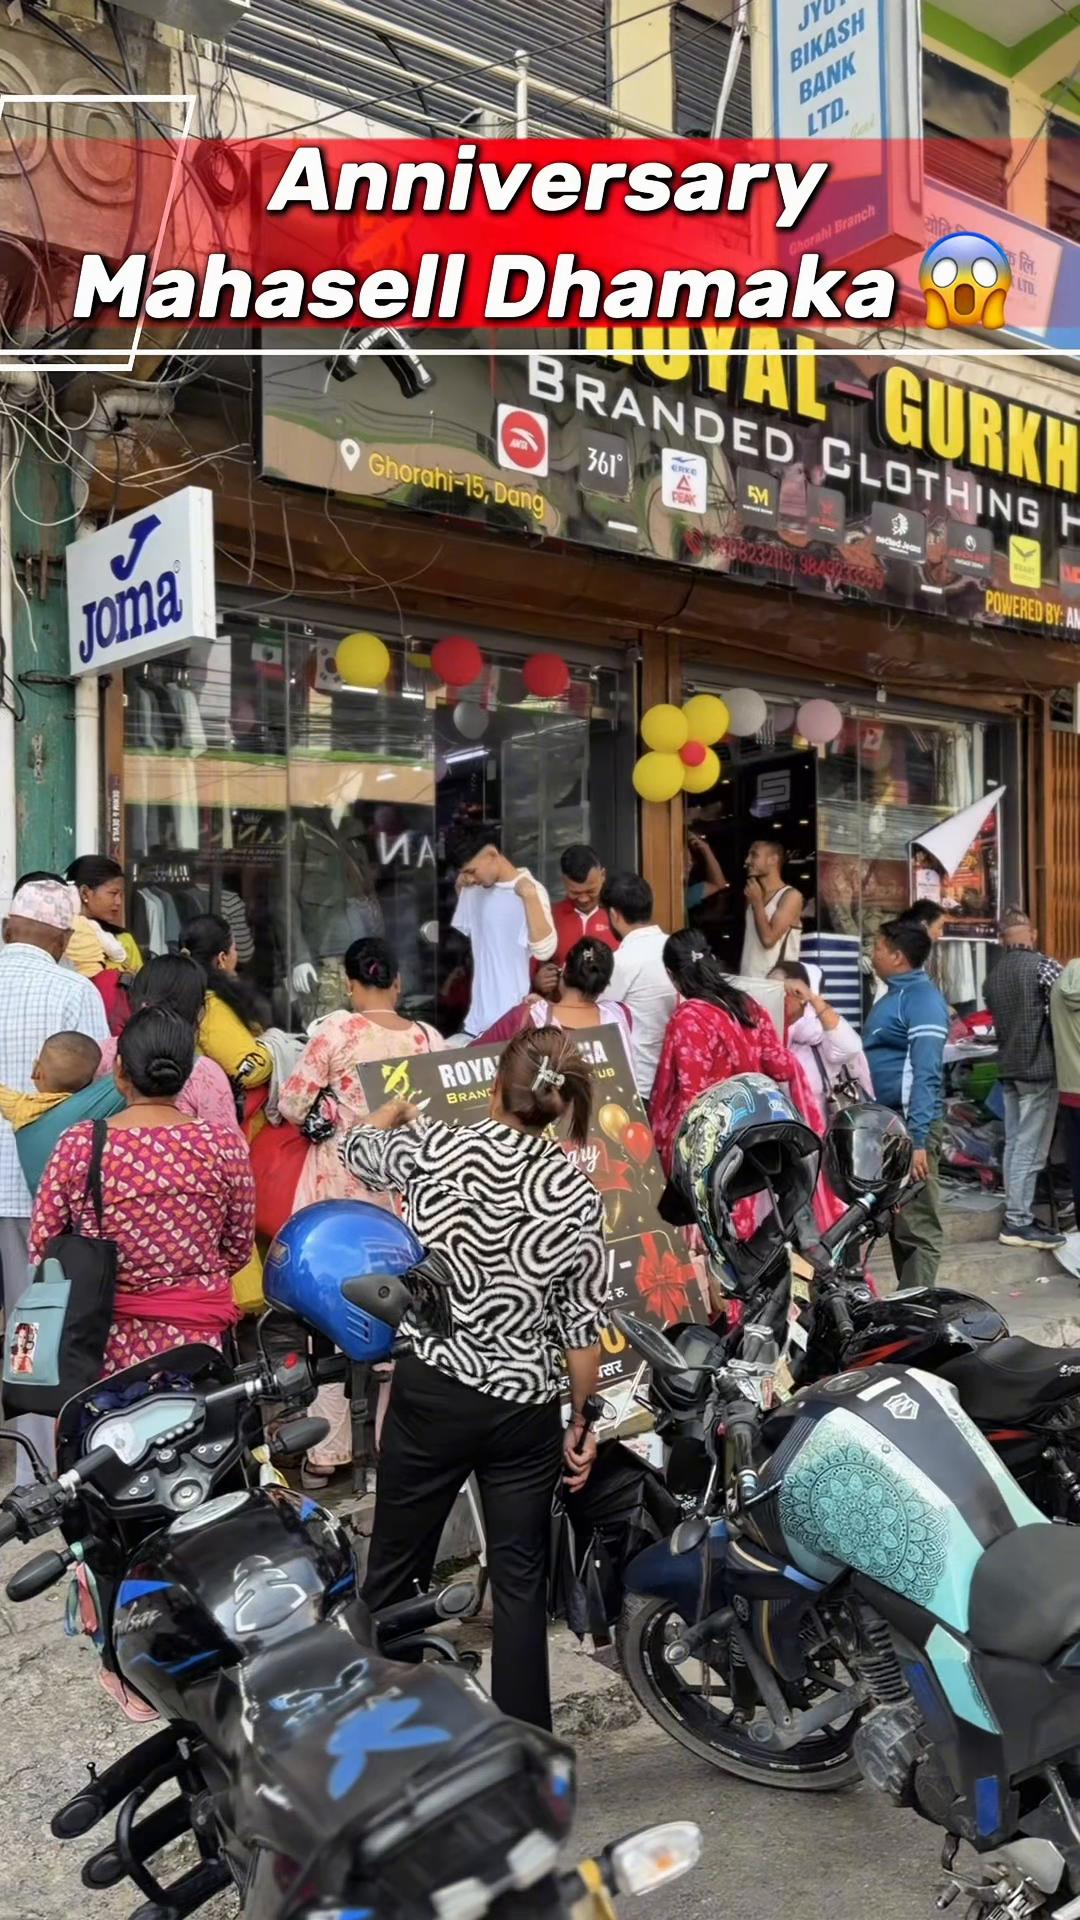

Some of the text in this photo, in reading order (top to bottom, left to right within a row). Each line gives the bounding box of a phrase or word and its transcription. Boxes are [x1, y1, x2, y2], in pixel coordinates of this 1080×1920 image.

[790, 7, 865, 73] BIKASH
[798, 0, 846, 31] JYO
[800, 52, 857, 105] BANK
[808, 98, 849, 137] LTD.
[834, 204, 876, 234] Branch
[528, 354, 794, 465] BRANDED
[823, 436, 1039, 529] CLOTHING
[885, 366, 1079, 494] GURKH
[368, 452, 544, 519] Ghorahi-15, Dang
[985, 589, 1043, 622] POWERED
[1046, 602, 1064, 627] BY:
